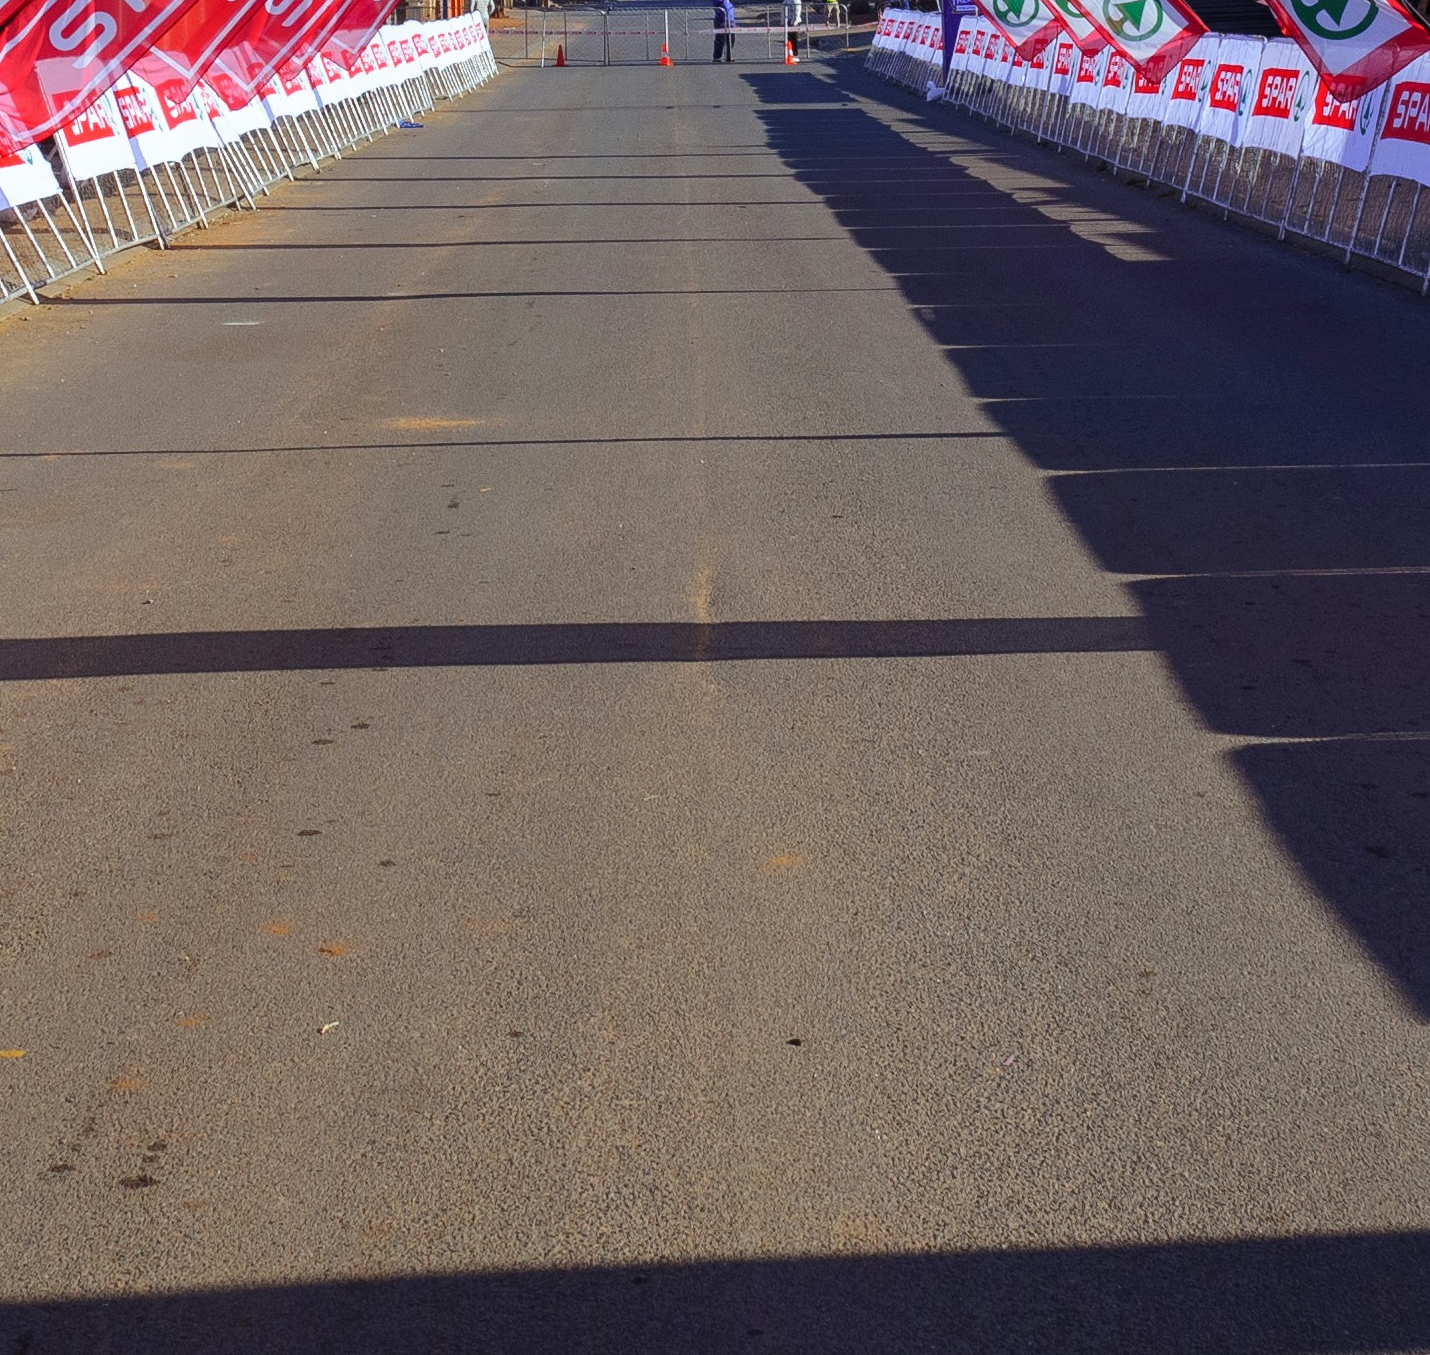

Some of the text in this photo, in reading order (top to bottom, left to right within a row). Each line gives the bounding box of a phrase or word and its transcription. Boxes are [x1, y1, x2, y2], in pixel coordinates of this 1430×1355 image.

[1214, 71, 1241, 104] SPAR
[1261, 76, 1297, 110] SPAR
[1323, 82, 1361, 122] SPAR
